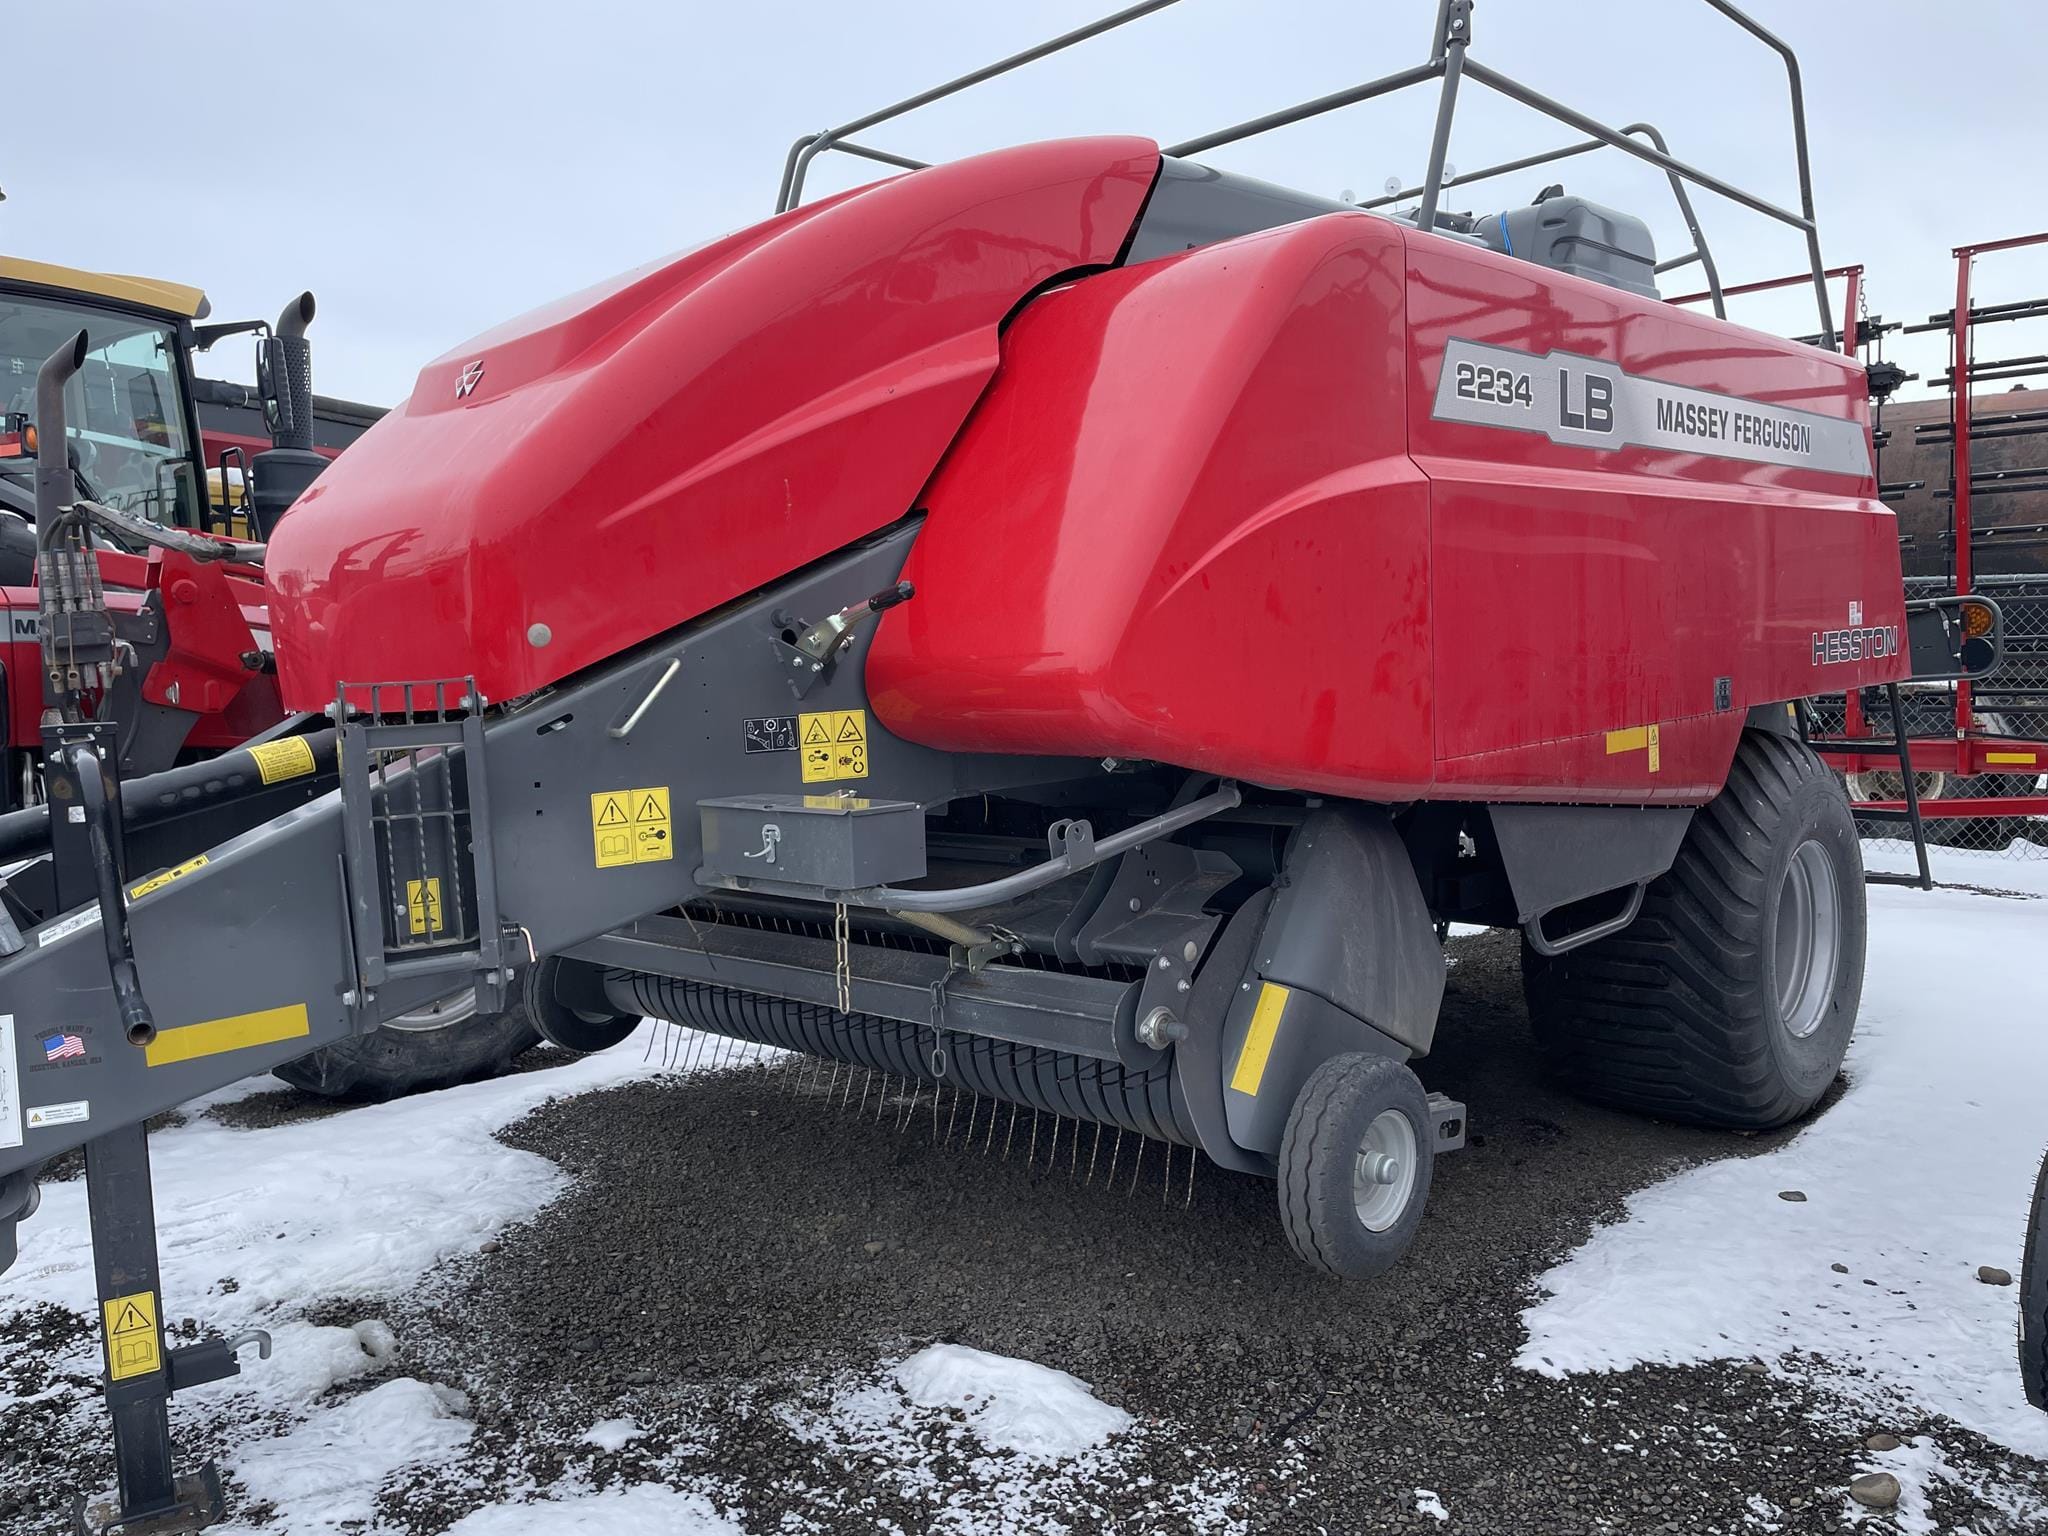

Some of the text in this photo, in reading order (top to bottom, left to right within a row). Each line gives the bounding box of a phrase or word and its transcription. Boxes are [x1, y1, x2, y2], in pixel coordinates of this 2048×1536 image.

[1456, 361, 1811, 454] 2234 LB MASSEY FERGUSON
[1812, 626, 1898, 666] HESSTON
